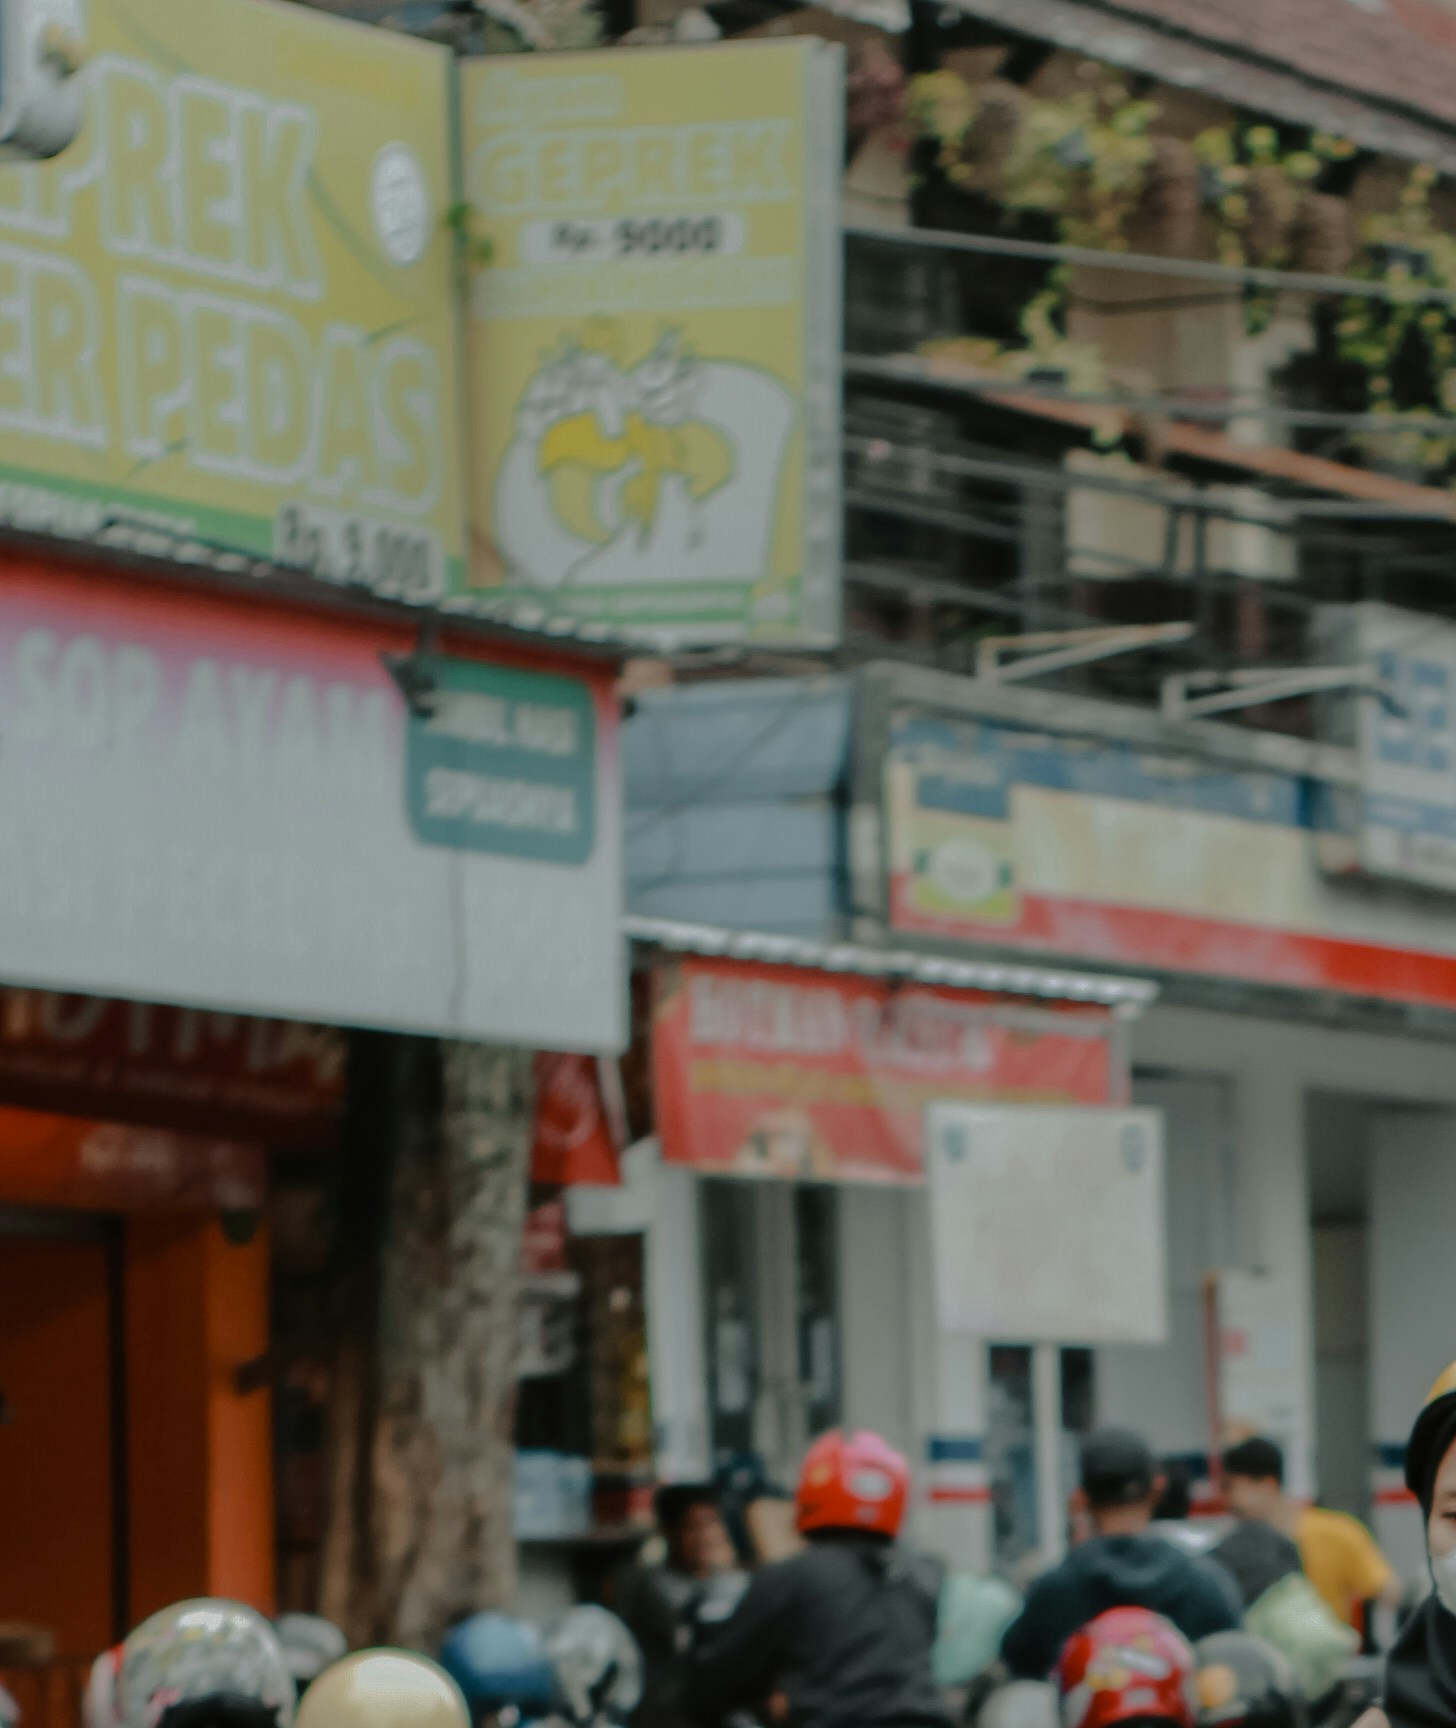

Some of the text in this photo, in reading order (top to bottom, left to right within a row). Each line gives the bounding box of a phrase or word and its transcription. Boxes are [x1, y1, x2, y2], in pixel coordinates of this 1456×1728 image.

[472, 120, 794, 213] GEPREK
[118, 275, 443, 516] PEDAS
[14, 626, 164, 755] SOP
